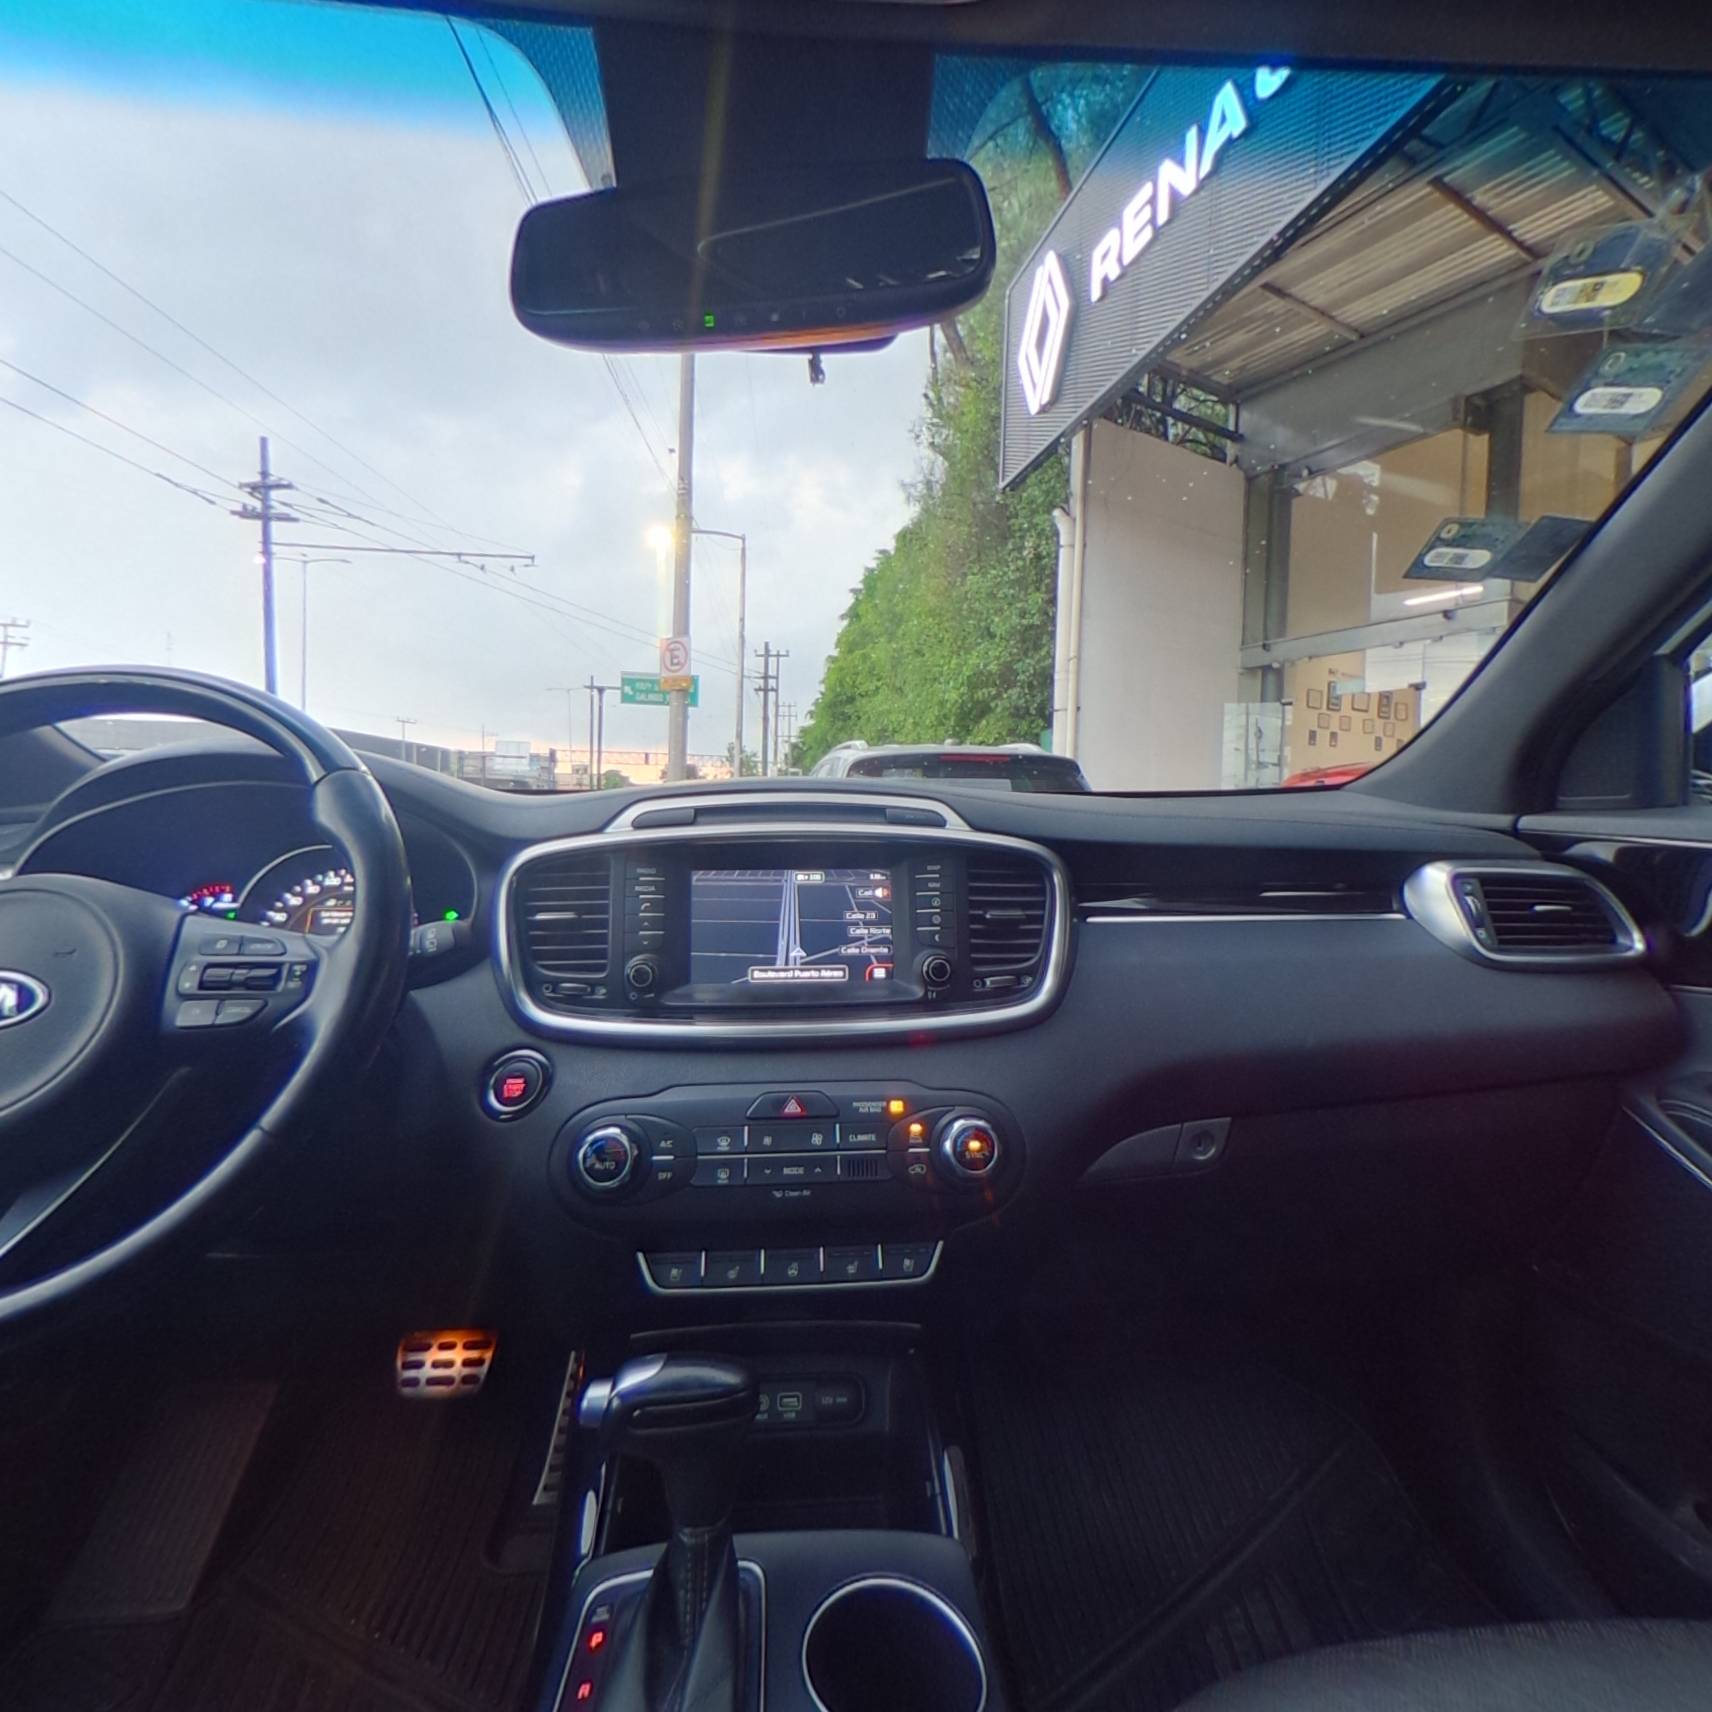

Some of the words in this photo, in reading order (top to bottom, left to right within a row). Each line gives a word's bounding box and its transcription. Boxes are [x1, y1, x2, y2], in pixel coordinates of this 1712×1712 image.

[670, 647, 681, 667] E
[753, 970, 793, 979] Boulevard
[594, 1162, 616, 1170] AUTO
[590, 1632, 603, 1649] P
